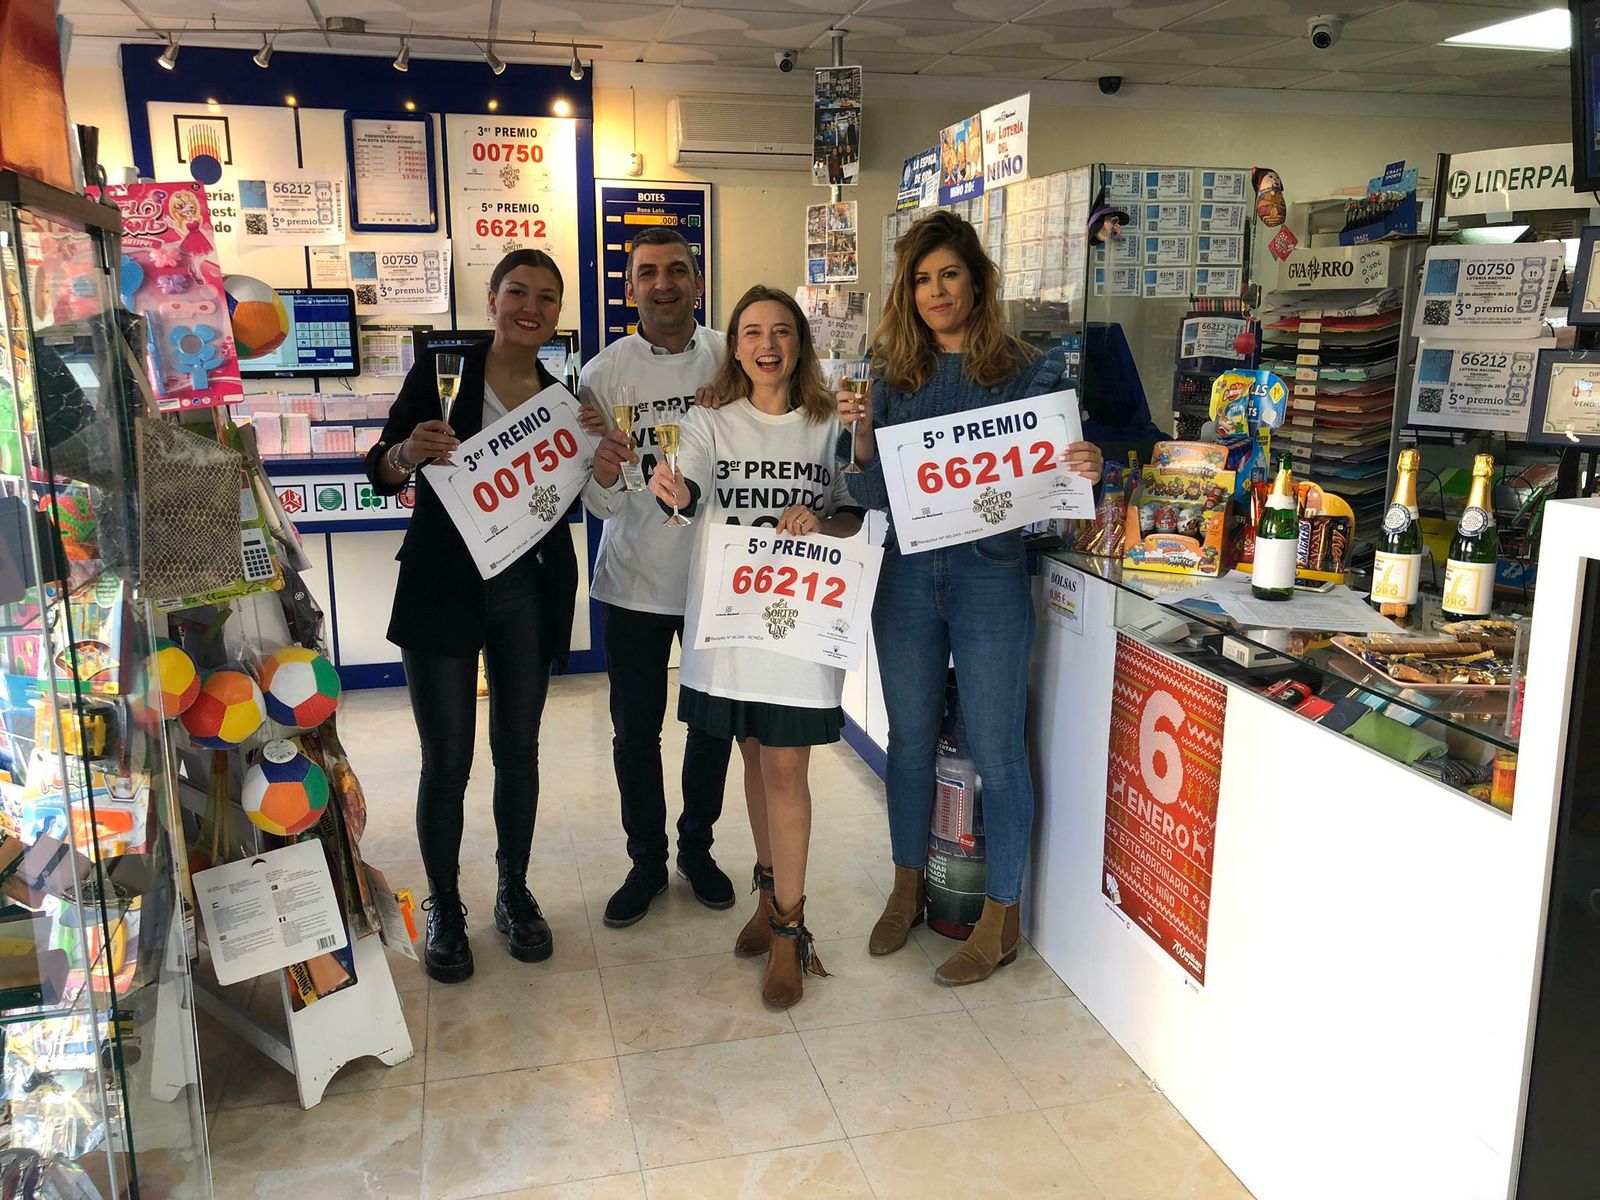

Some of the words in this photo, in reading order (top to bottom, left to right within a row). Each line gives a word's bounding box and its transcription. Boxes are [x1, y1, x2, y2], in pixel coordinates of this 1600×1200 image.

[495, 127, 537, 138] PREMIO
[472, 143, 544, 163] 00750
[998, 142, 1008, 154] DEL
[987, 154, 1023, 182] NIÑO
[273, 182, 311, 195] 66212
[1474, 164, 1575, 194] LIDERPA
[638, 192, 665, 202] BOTES
[481, 202, 493, 212] 5º
[497, 203, 540, 214] PREMIO
[272, 217, 285, 228] 5º
[286, 218, 318, 227] premio
[476, 218, 547, 238] 66212
[381, 255, 419, 266] 00750
[1466, 263, 1515, 276] 00750
[380, 287, 393, 297] 3º
[395, 288, 425, 296] premio
[1455, 303, 1472, 316] 3º
[1474, 304, 1514, 315] premio
[836, 321, 859, 331] PREMIO
[1202, 322, 1226, 331] 66212
[1461, 353, 1508, 368] 66212
[652, 395, 696, 414] PRE
[1448, 393, 1465, 405] 5º
[1466, 396, 1504, 406] premio
[464, 448, 485, 472] 3er
[488, 406, 552, 457] PREMIO
[631, 427, 660, 448] VE
[923, 430, 945, 449] 5º
[952, 411, 1038, 444] PREMIO
[472, 428, 578, 513] 00750
[716, 460, 741, 480] 3er
[744, 461, 831, 487] PREMIO
[917, 441, 1057, 494] 66212
[717, 487, 824, 512] VENDIDO
[972, 490, 1012, 513] SORTEO
[748, 538, 767, 555] 5º
[772, 539, 842, 565] PREMIO
[732, 565, 847, 609] 66212
[1051, 572, 1077, 592] BOLSAS
[761, 606, 799, 620] SORTEO
[1139, 689, 1186, 805] 6
[1127, 785, 1190, 850] ENERO
[1139, 826, 1173, 862] SORTEO
[1119, 832, 1190, 898] EXTRAORDINARIO
[1130, 861, 1142, 880] DE
[1143, 871, 1154, 890] EL
[1155, 882, 1175, 908] NIÑO
[1172, 938, 1186, 959] 700
